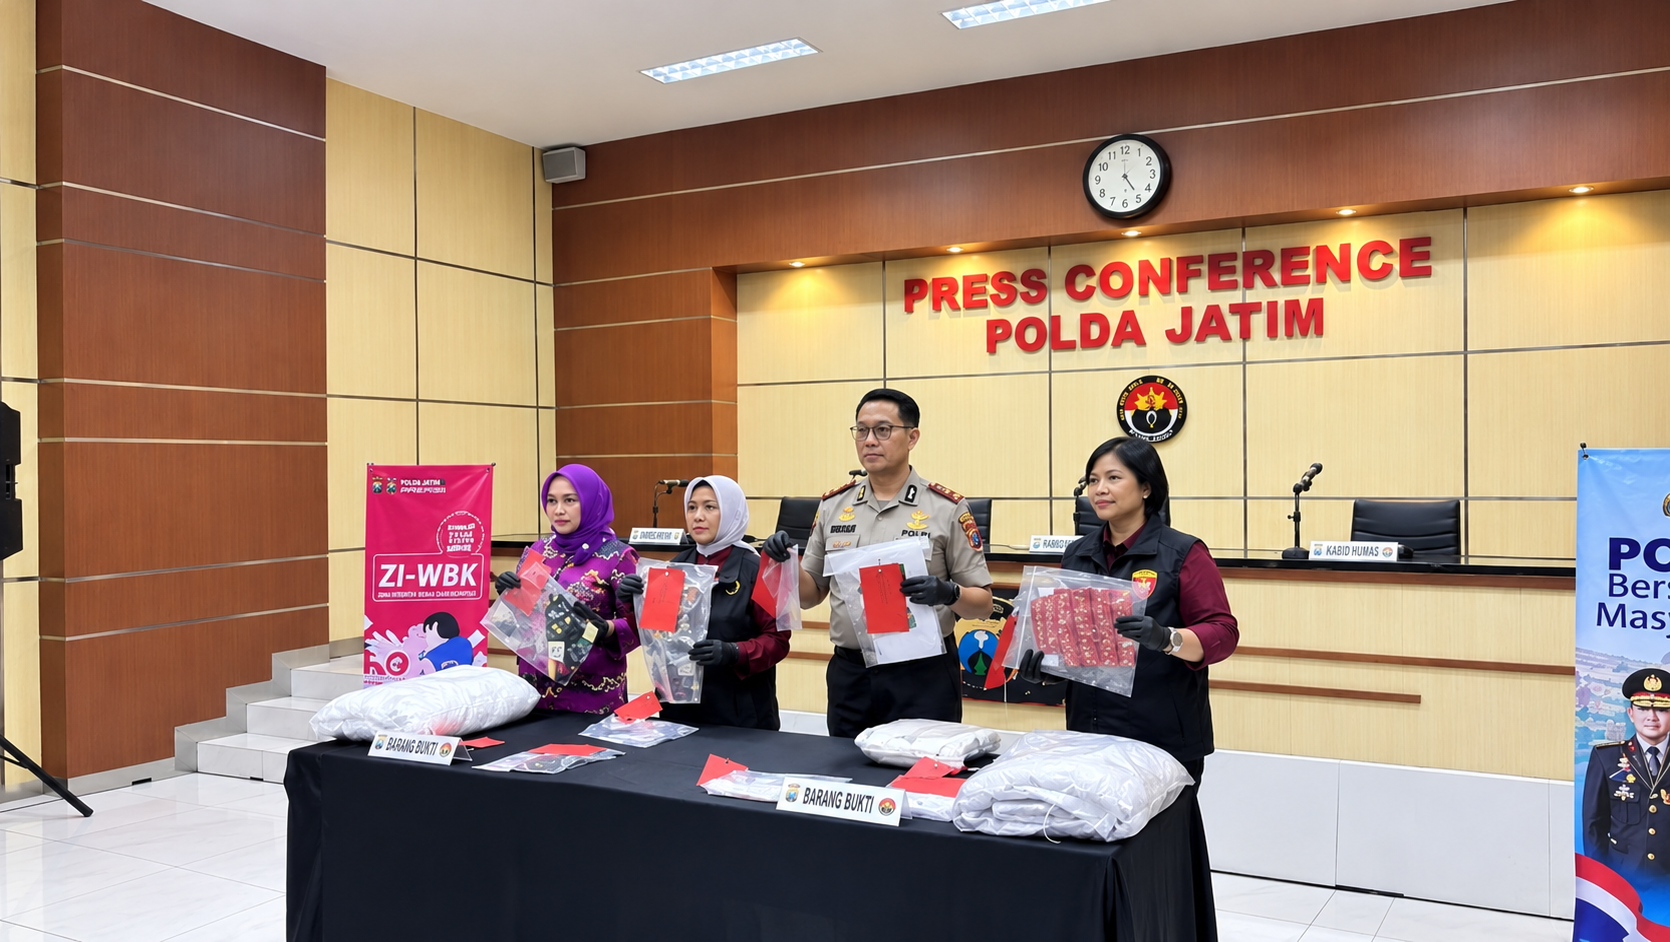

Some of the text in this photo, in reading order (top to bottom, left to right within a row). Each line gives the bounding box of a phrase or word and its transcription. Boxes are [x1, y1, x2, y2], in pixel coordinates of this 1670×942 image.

[1120, 145, 1130, 155] 12
[1108, 151, 1116, 160] 11
[1145, 156, 1152, 166] 2
[1098, 162, 1108, 172] 10
[1149, 169, 1156, 179] 3
[1094, 175, 1101, 185] 9
[1144, 183, 1152, 192] 4
[1099, 188, 1106, 198] 8
[1110, 196, 1116, 206] 7
[1122, 199, 1128, 208] 6
[1135, 194, 1142, 203] 5
[904, 236, 1432, 314] PRESS CONFERENCE
[986, 297, 1324, 354] POLDA JATIM
[1326, 545, 1379, 557] KABID HUMAS
[378, 563, 479, 588] ZI-WBK
[1608, 573, 1670, 599] Ber
[1596, 602, 1670, 639] Mas
[385, 737, 439, 756] BARANG BUKTI
[802, 787, 875, 814] BARANG BUKTI
